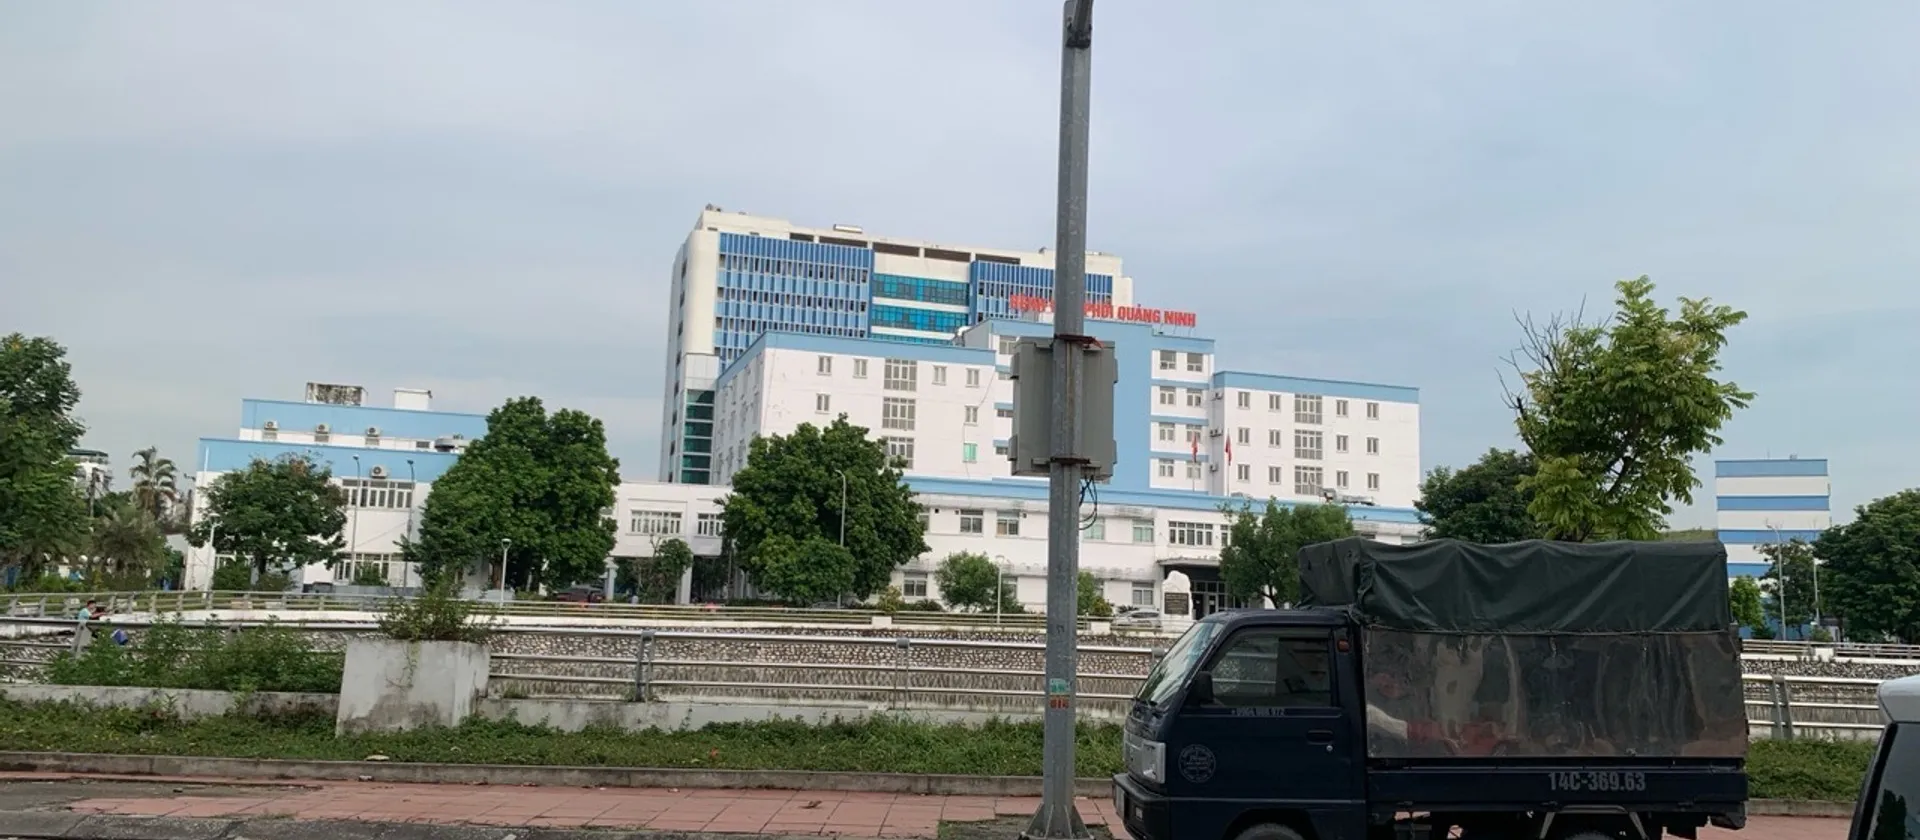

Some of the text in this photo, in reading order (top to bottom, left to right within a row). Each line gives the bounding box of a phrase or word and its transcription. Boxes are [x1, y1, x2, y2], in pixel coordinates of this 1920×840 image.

[1118, 304, 1160, 323] QUẢNG
[1164, 310, 1196, 327] NINH
[1548, 771, 1646, 791] 14C-369.63
